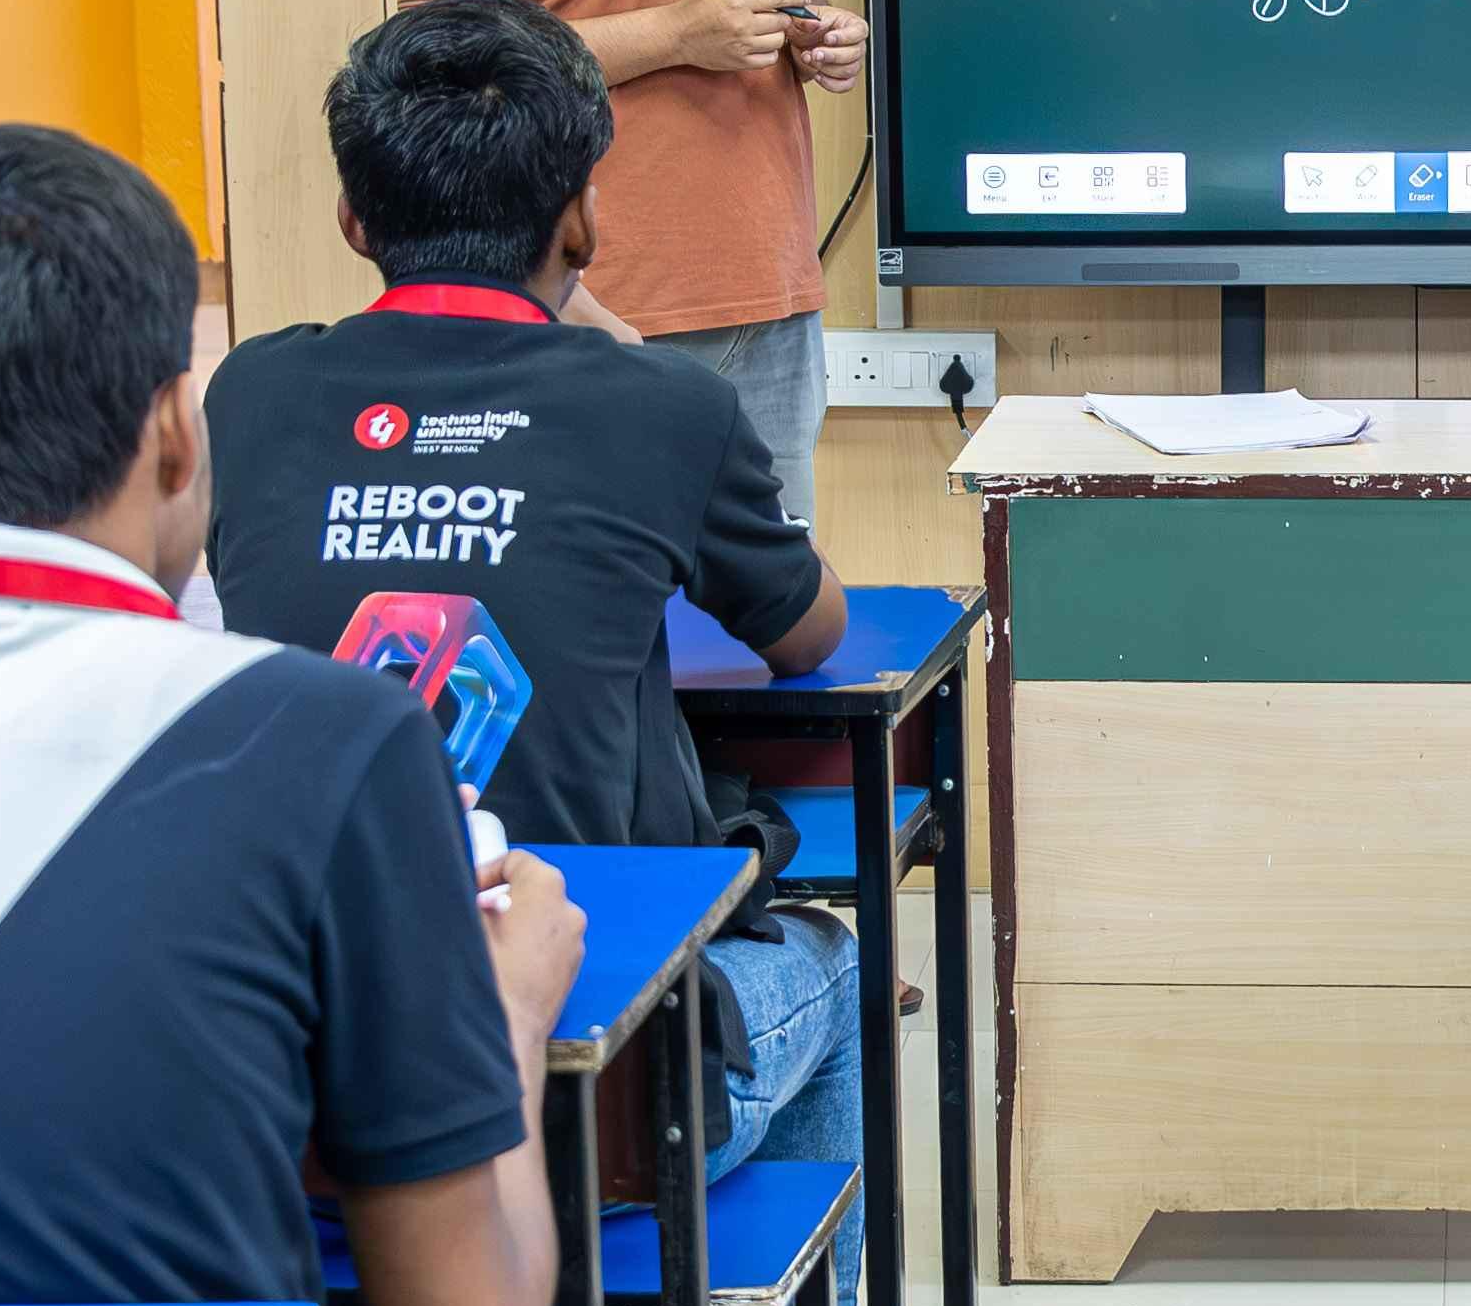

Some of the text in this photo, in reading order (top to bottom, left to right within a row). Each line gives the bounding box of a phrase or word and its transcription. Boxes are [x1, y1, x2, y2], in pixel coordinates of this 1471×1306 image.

[1408, 192, 1435, 201] Eraser
[420, 414, 482, 427] techno
[416, 424, 507, 441] university
[413, 445, 480, 454] WEST BENGAL
[328, 485, 525, 525] REBOOT
[323, 523, 517, 566] REALITY
